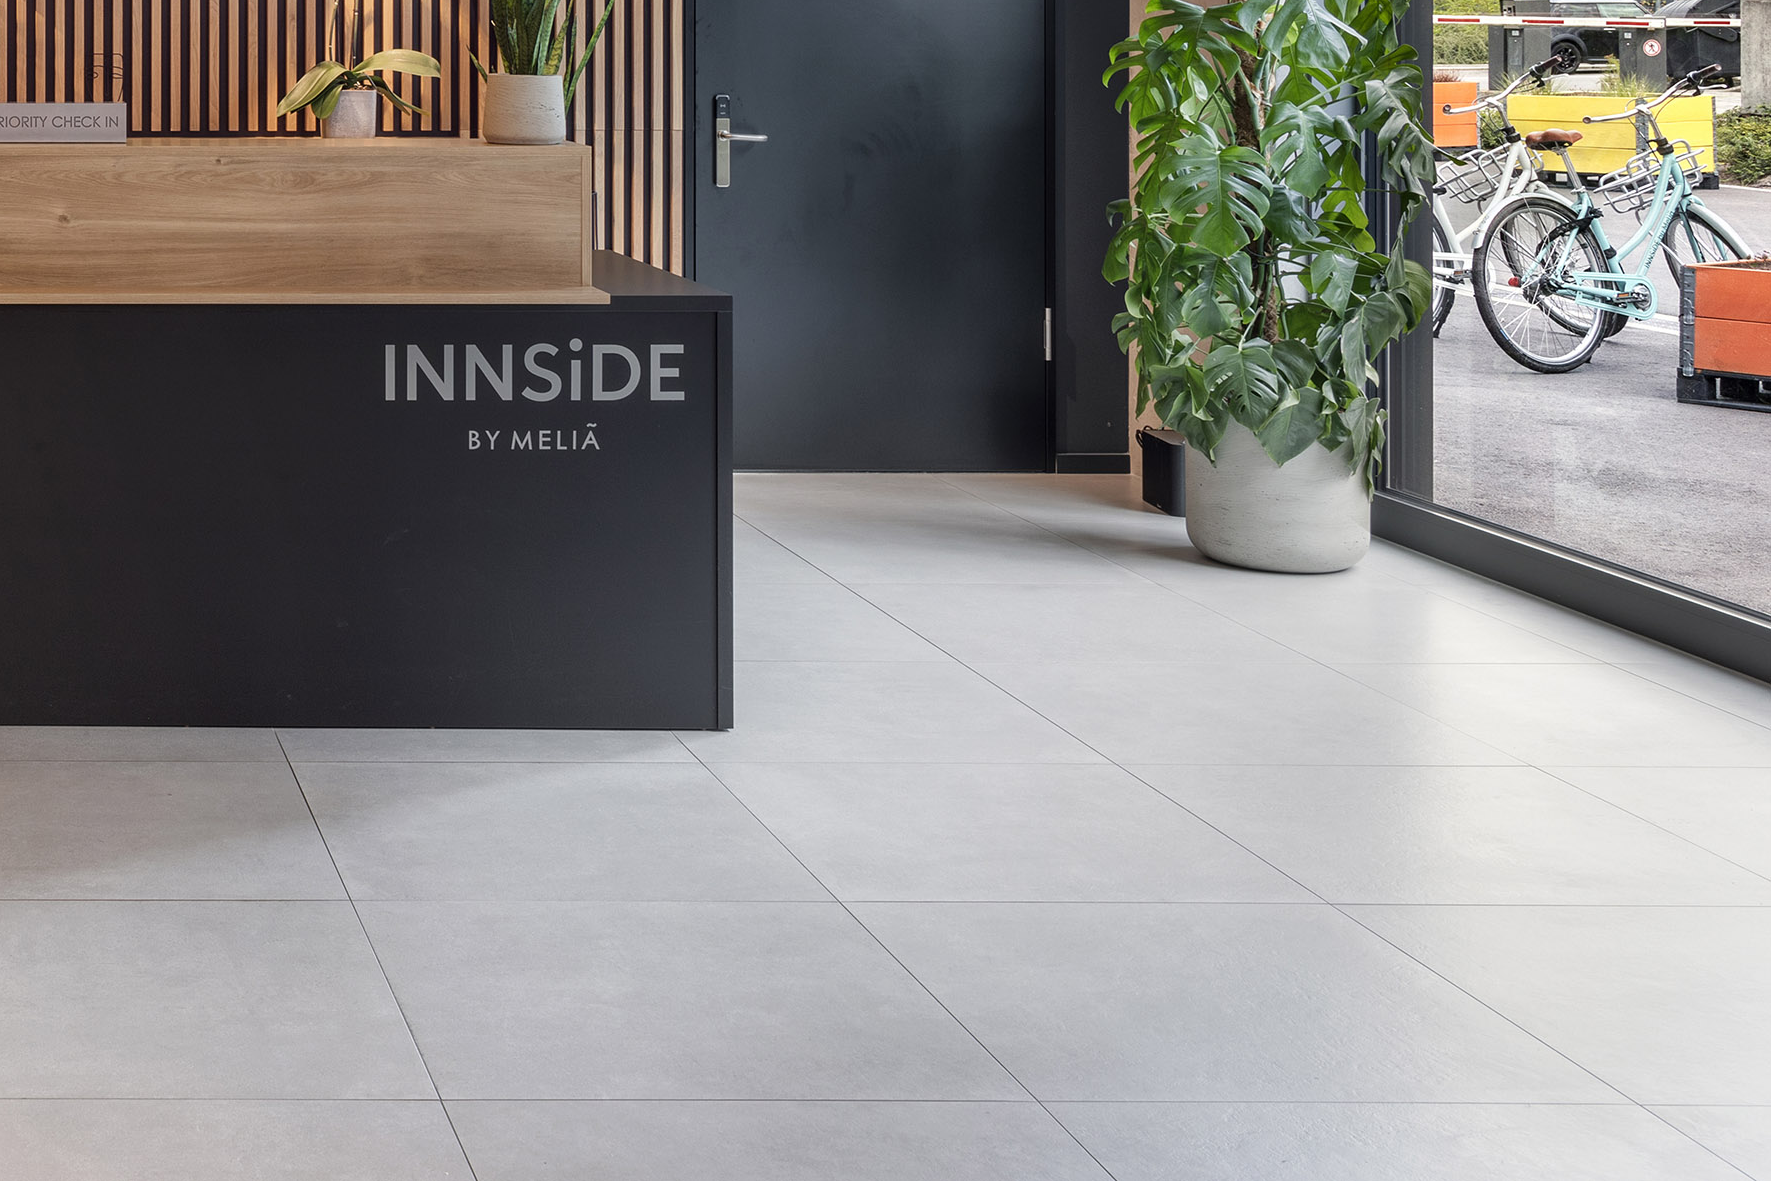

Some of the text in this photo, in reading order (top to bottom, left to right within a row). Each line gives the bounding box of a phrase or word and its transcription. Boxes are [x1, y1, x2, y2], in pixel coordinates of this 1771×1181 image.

[51, 115, 101, 128] CHECK
[105, 116, 119, 128] IN
[385, 338, 685, 402] INNSiDE
[468, 430, 501, 450] BY
